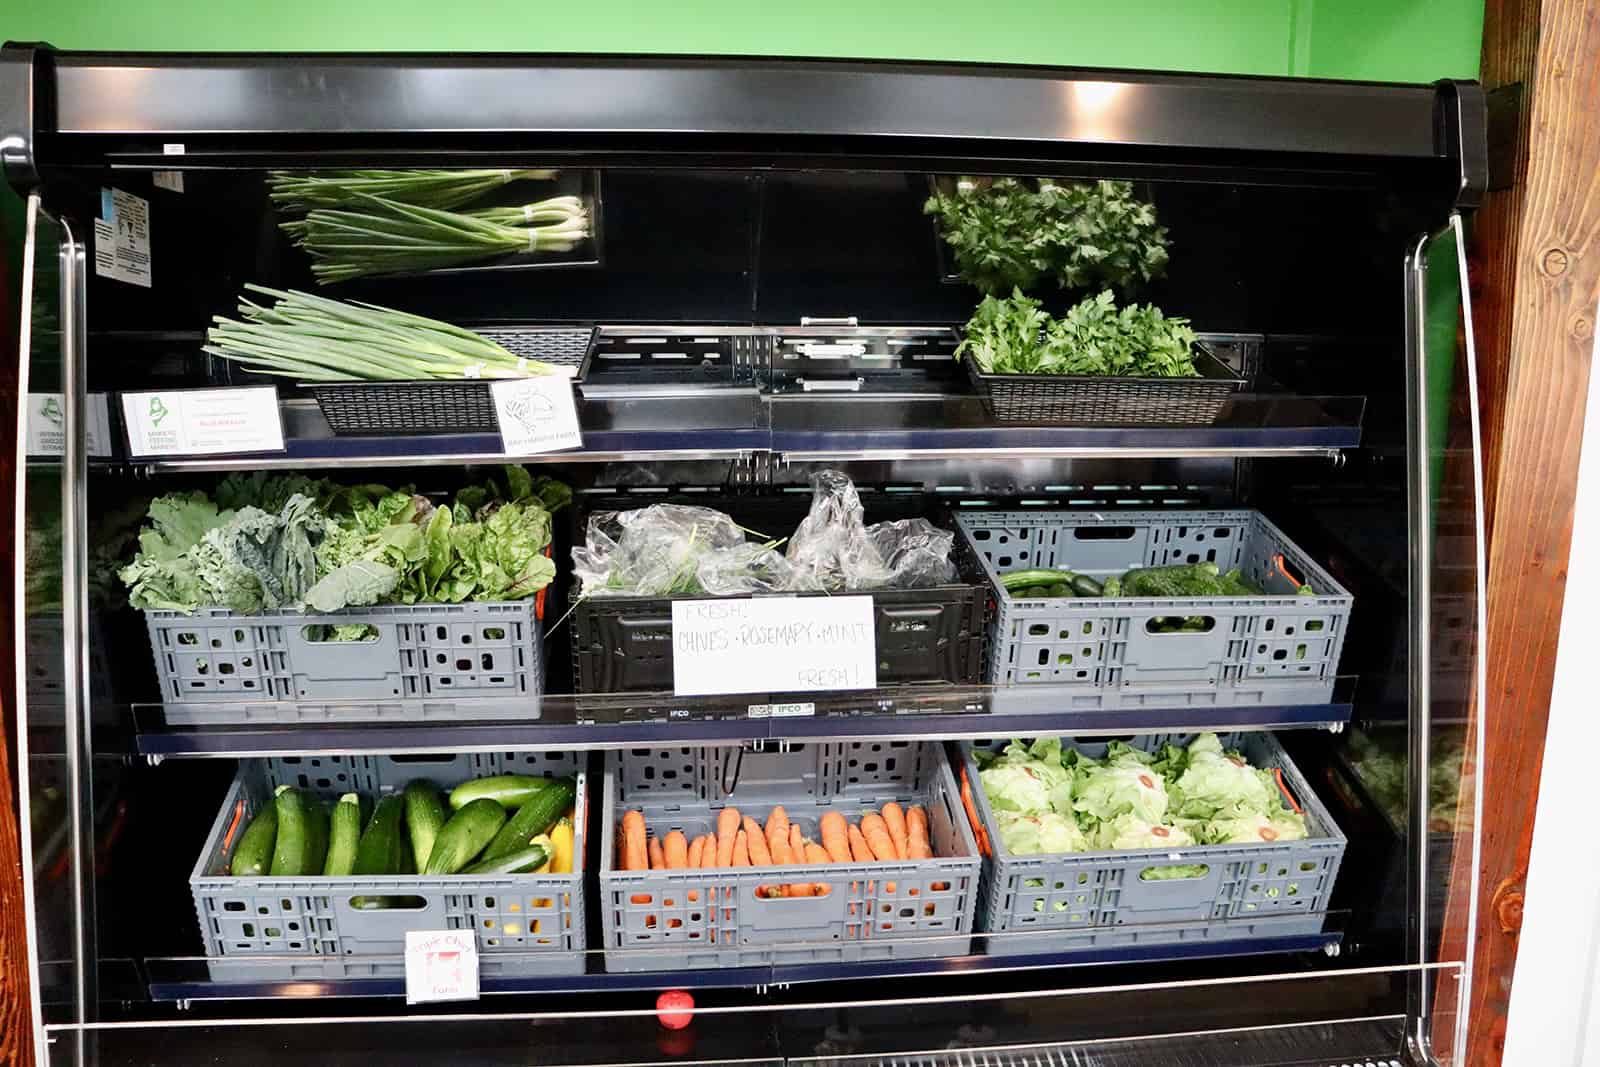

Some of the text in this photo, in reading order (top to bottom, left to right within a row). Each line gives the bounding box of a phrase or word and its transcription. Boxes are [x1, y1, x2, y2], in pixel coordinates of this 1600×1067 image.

[678, 622, 867, 653] CHIVES ROSEMARY MINT
[778, 704, 801, 713] IFCO
